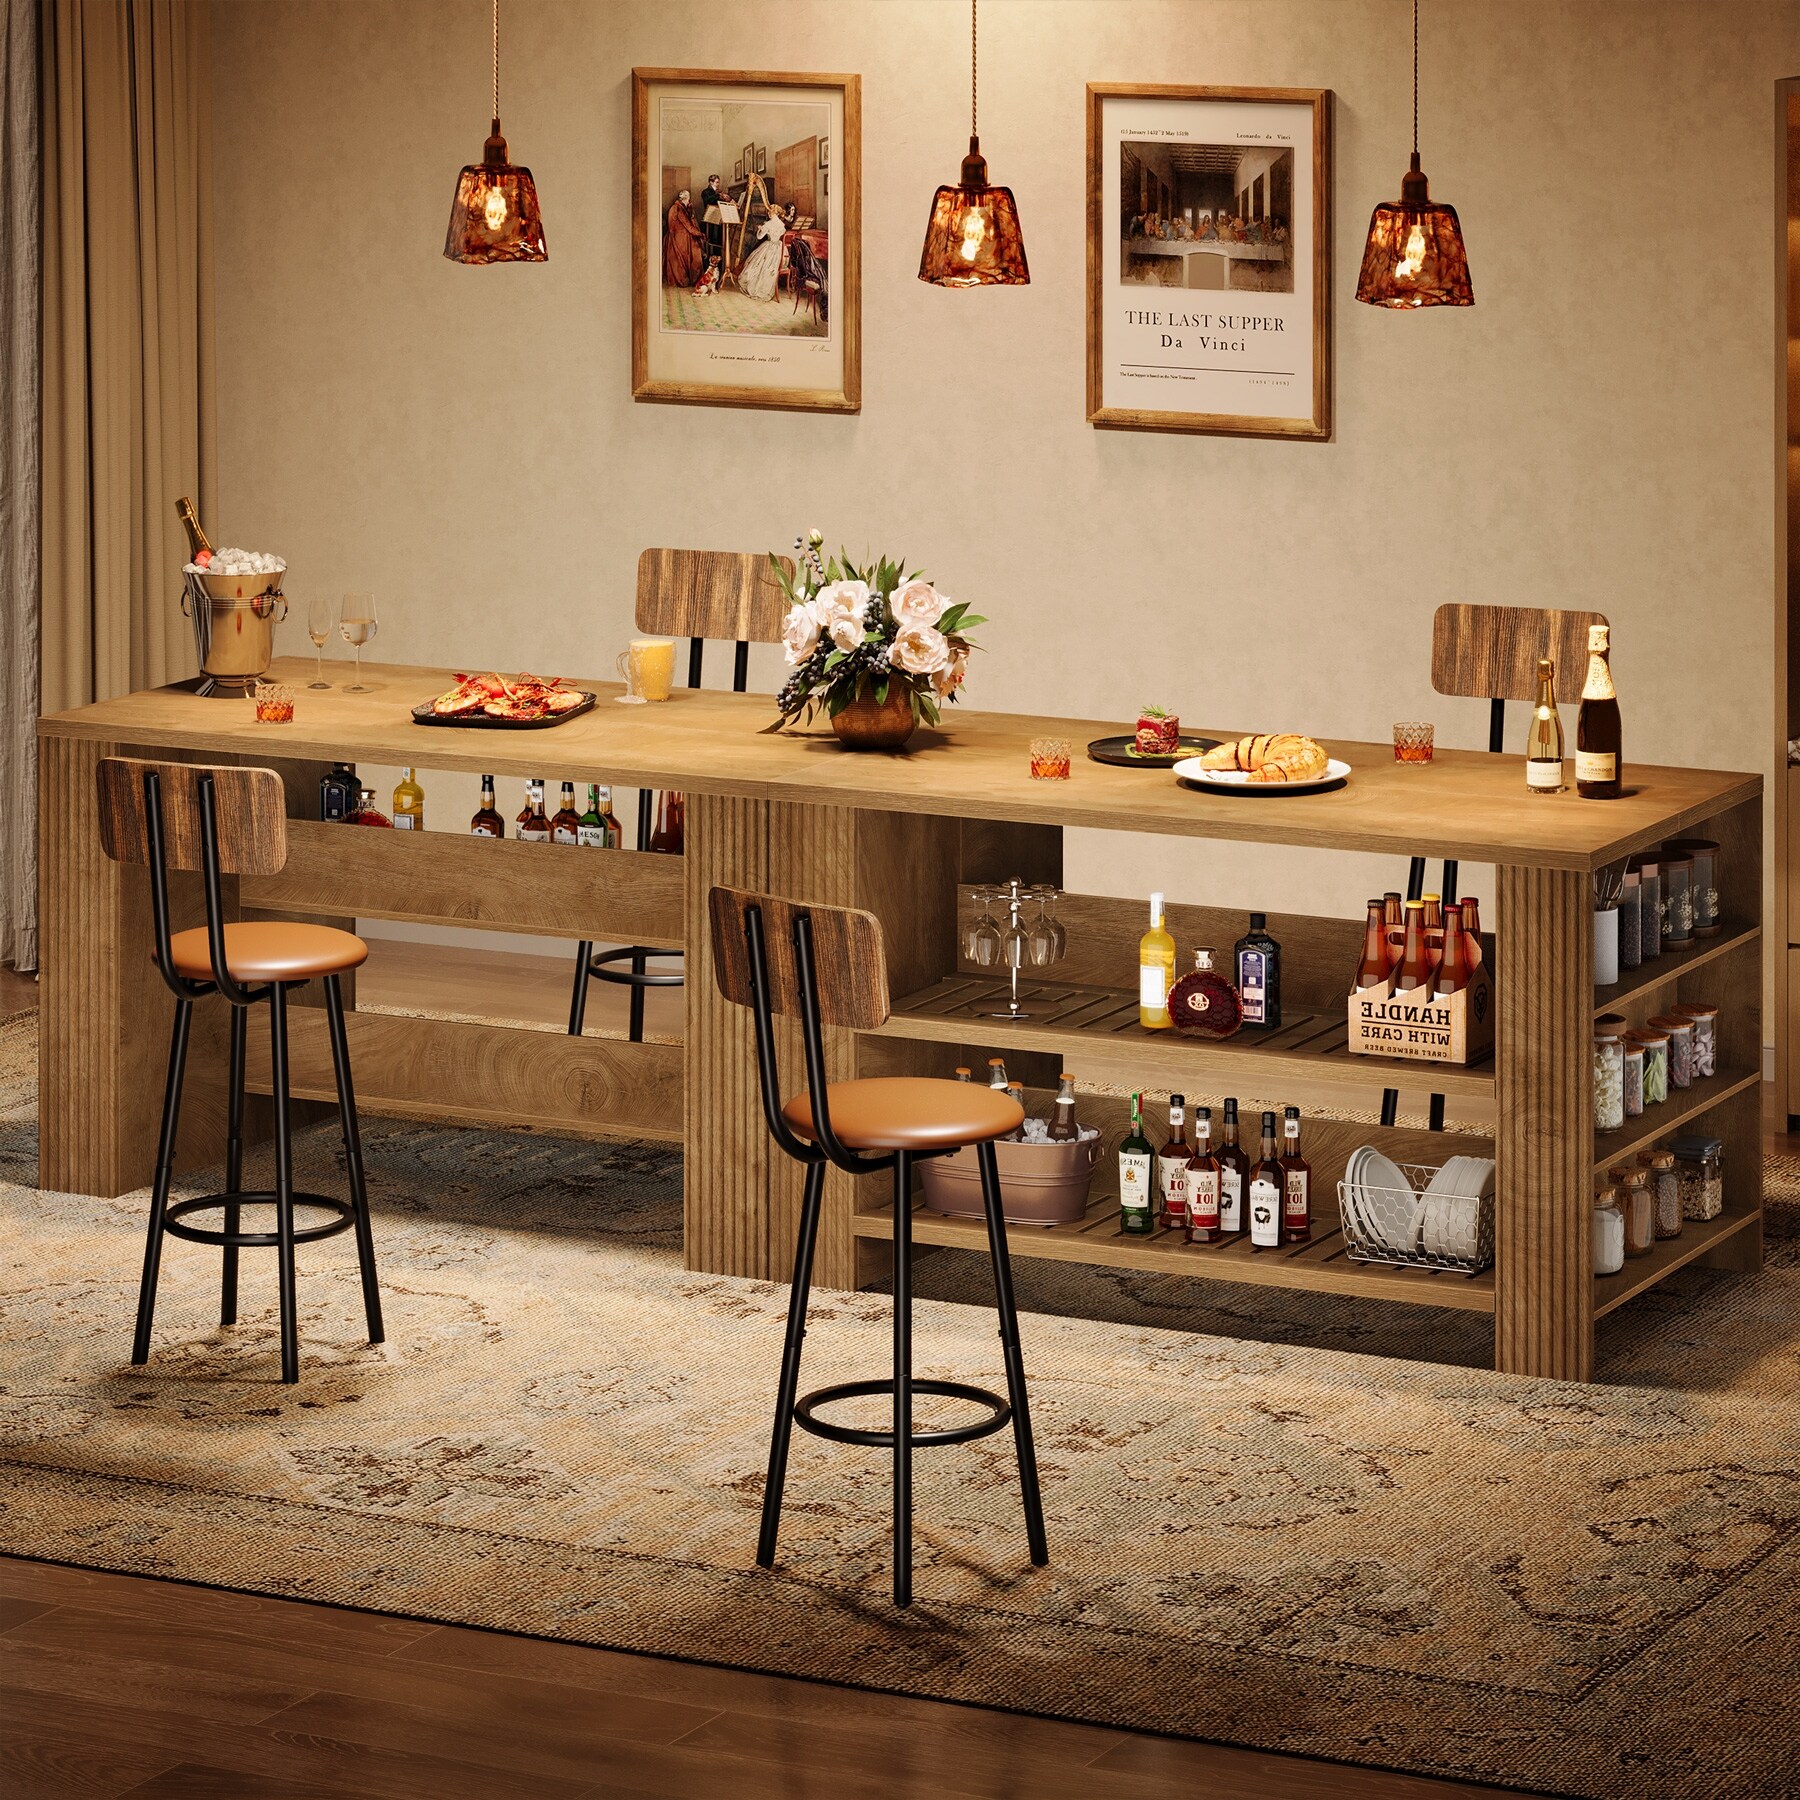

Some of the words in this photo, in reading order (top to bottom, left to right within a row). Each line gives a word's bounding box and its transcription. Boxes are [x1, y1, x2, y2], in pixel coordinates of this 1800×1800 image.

[1125, 310, 1162, 326] THE
[1168, 312, 1212, 328] LAST
[1218, 314, 1285, 332] SUPPER
[1161, 334, 1183, 348] Da
[1200, 336, 1245, 351] Vinci
